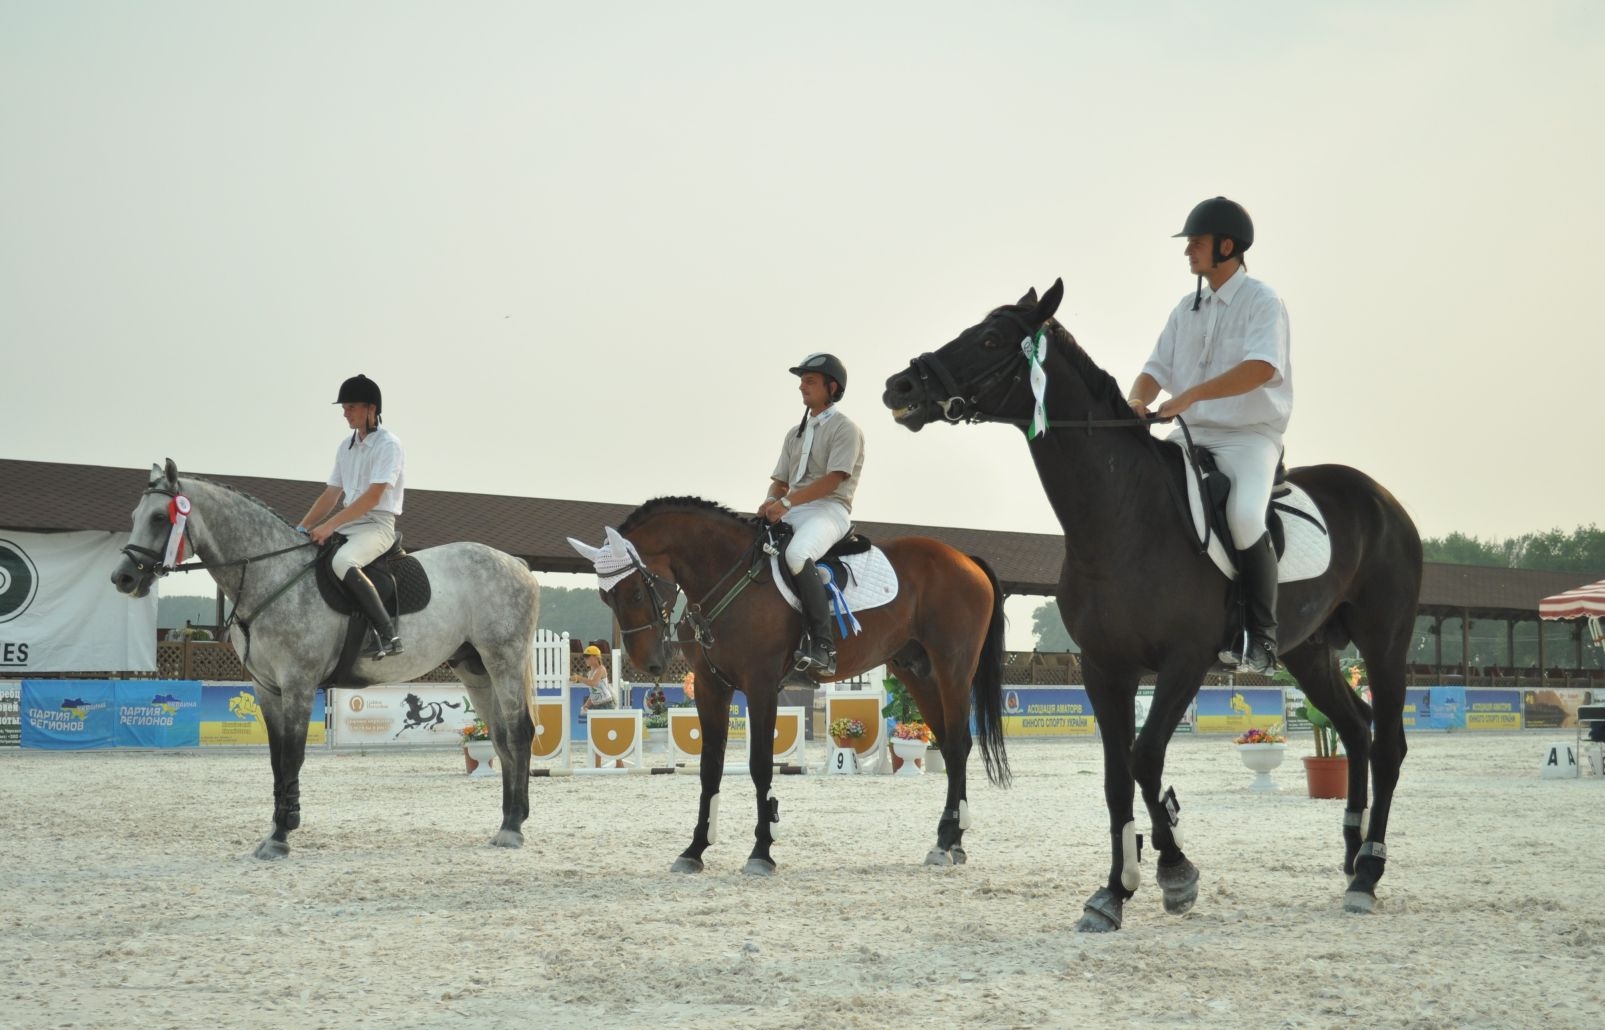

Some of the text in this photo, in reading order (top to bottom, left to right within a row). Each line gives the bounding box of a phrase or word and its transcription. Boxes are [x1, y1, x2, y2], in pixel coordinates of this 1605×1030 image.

[0, 643, 29, 663] ES
[29, 708, 71, 721] ПАРТИЯ
[120, 706, 161, 716] ПАРТИЯ
[30, 718, 84, 731] РЕГИОНОВ
[120, 716, 174, 726] РЕГИОНОВ
[837, 752, 844, 769] 9
[1547, 747, 1576, 766] A A
